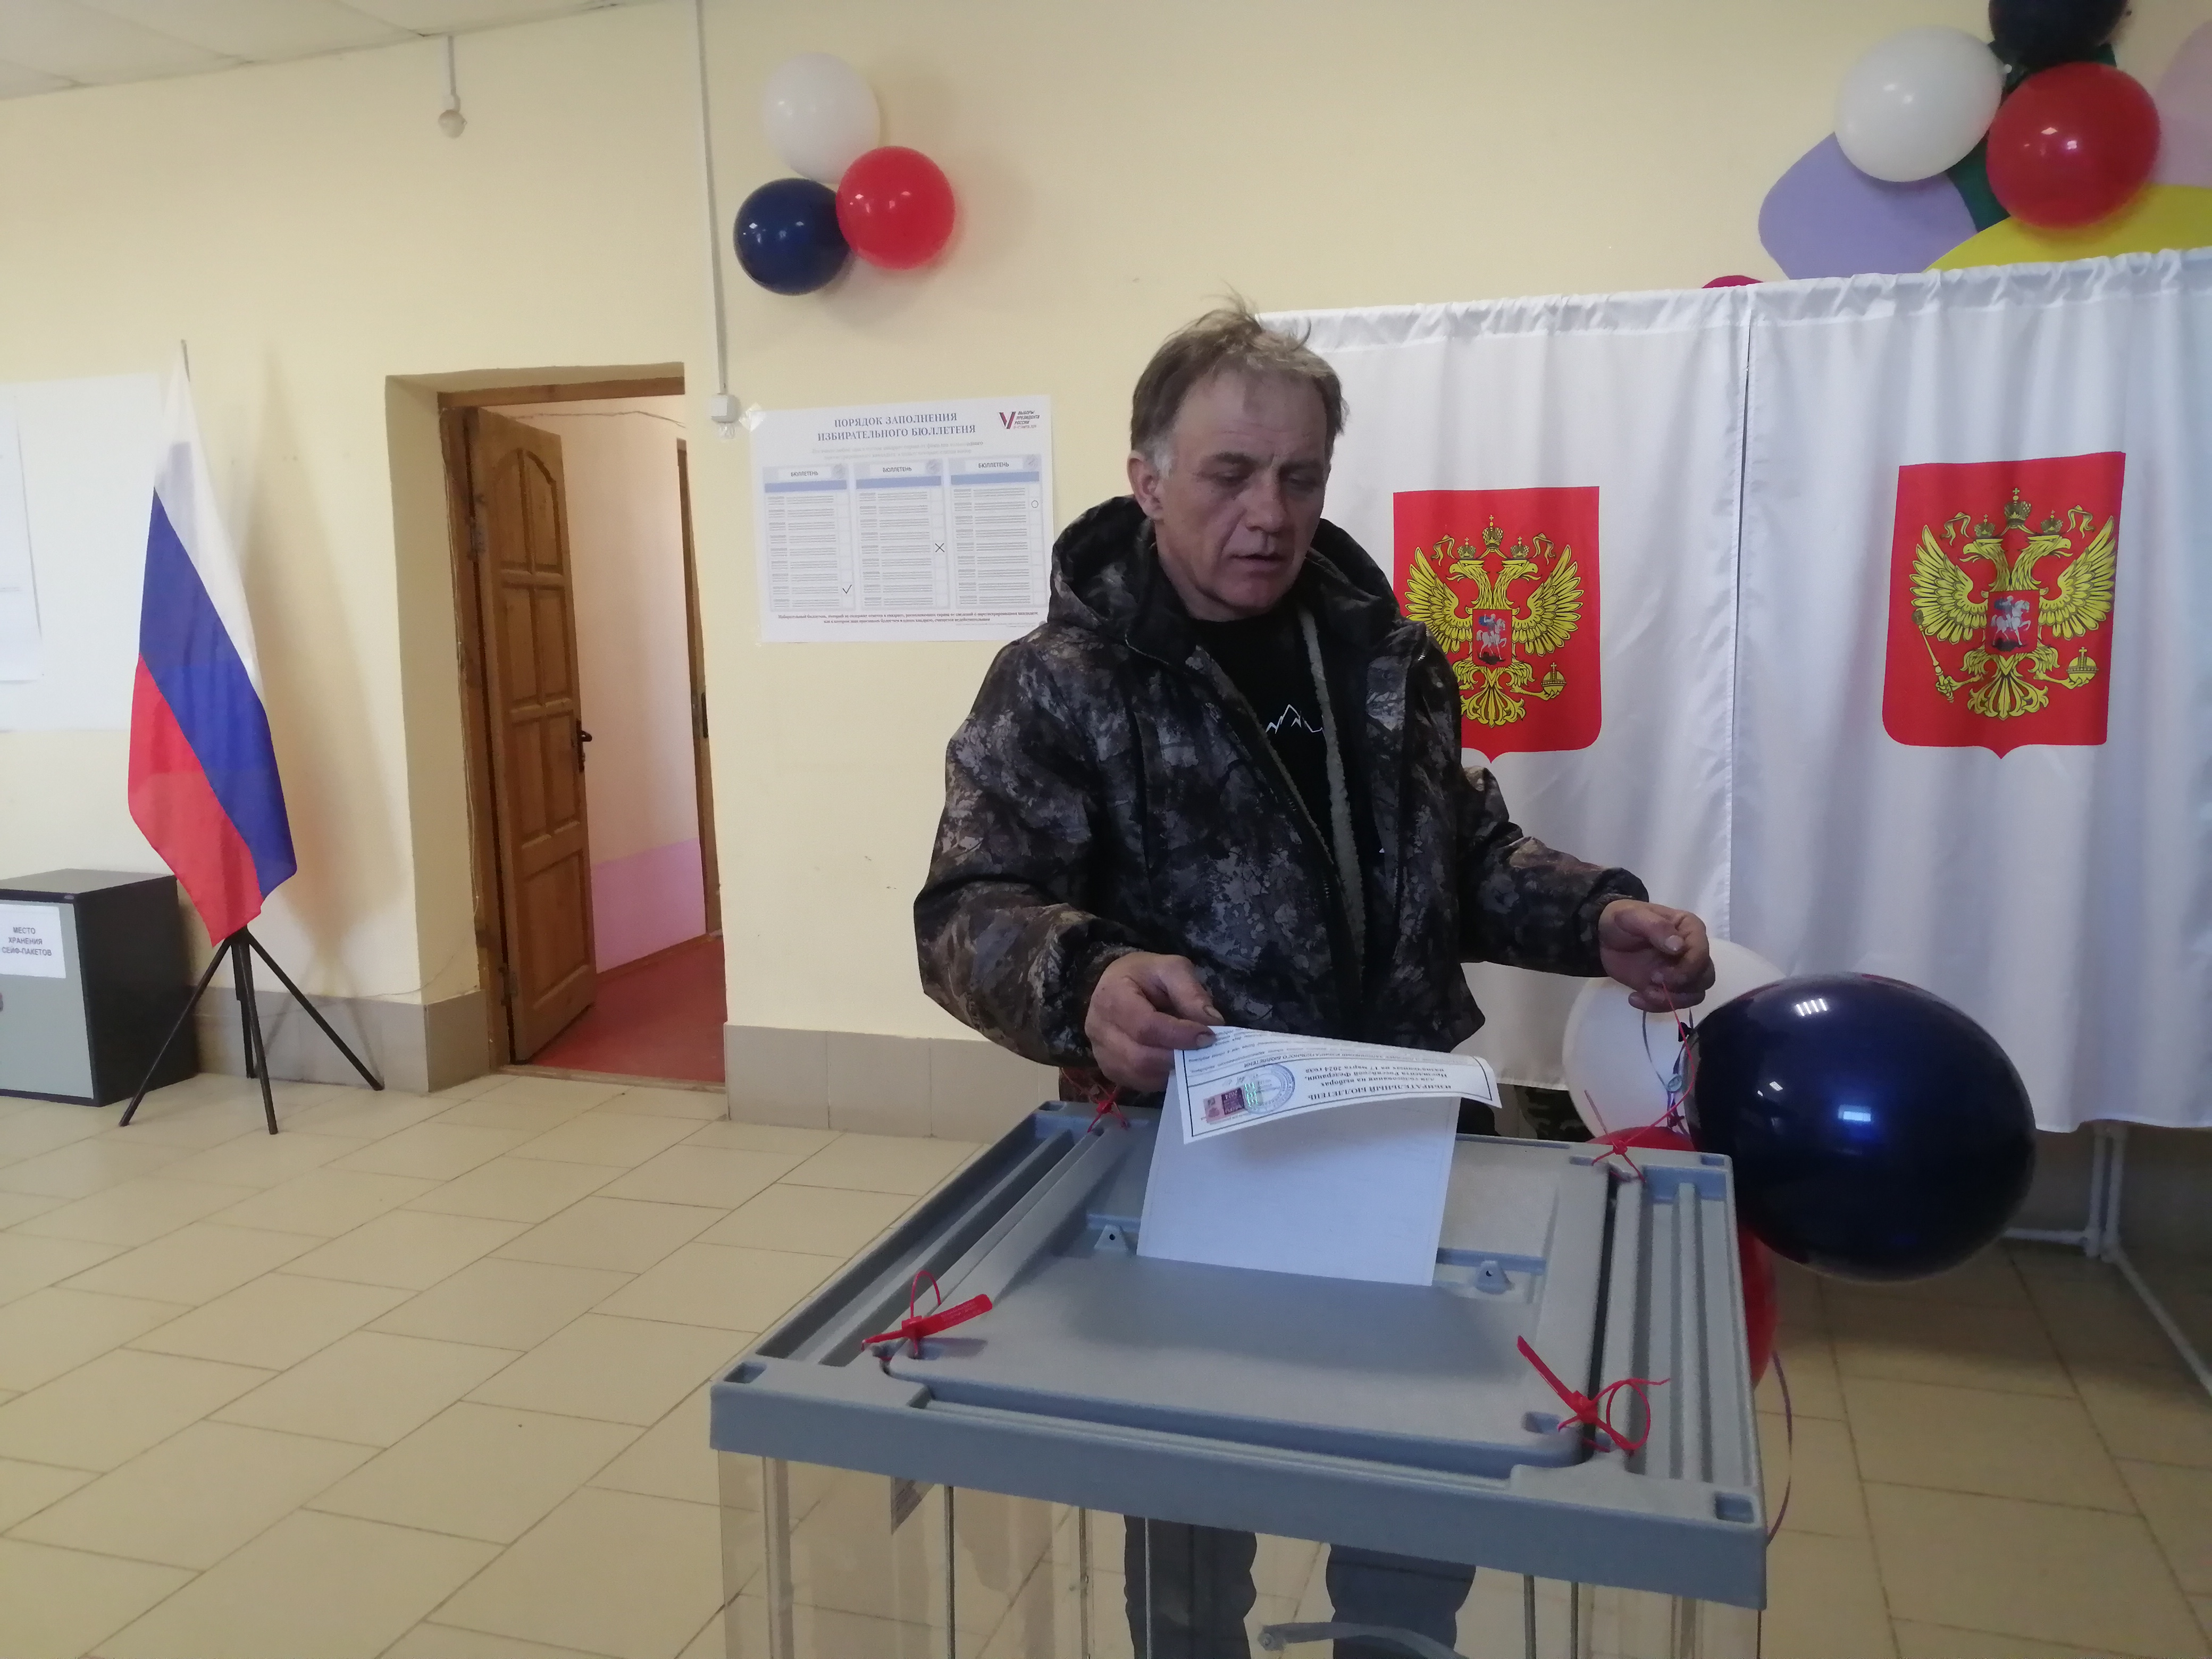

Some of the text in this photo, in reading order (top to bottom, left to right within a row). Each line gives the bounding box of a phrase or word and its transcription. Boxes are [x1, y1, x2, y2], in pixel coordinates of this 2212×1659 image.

[834, 413, 957, 428] ПОРЯДОК ЗАПОЛНЕНИЯ
[818, 425, 976, 441] ИЗБИРАТЕЛЬНОГО БЮЛЛЕТЕНЯ
[8, 936, 43, 945] ХРАНЕНИЯ
[2, 946, 52, 956] СЕЙФ-ПАКЕТОВ
[1225, 1090, 1238, 1099] 2024
